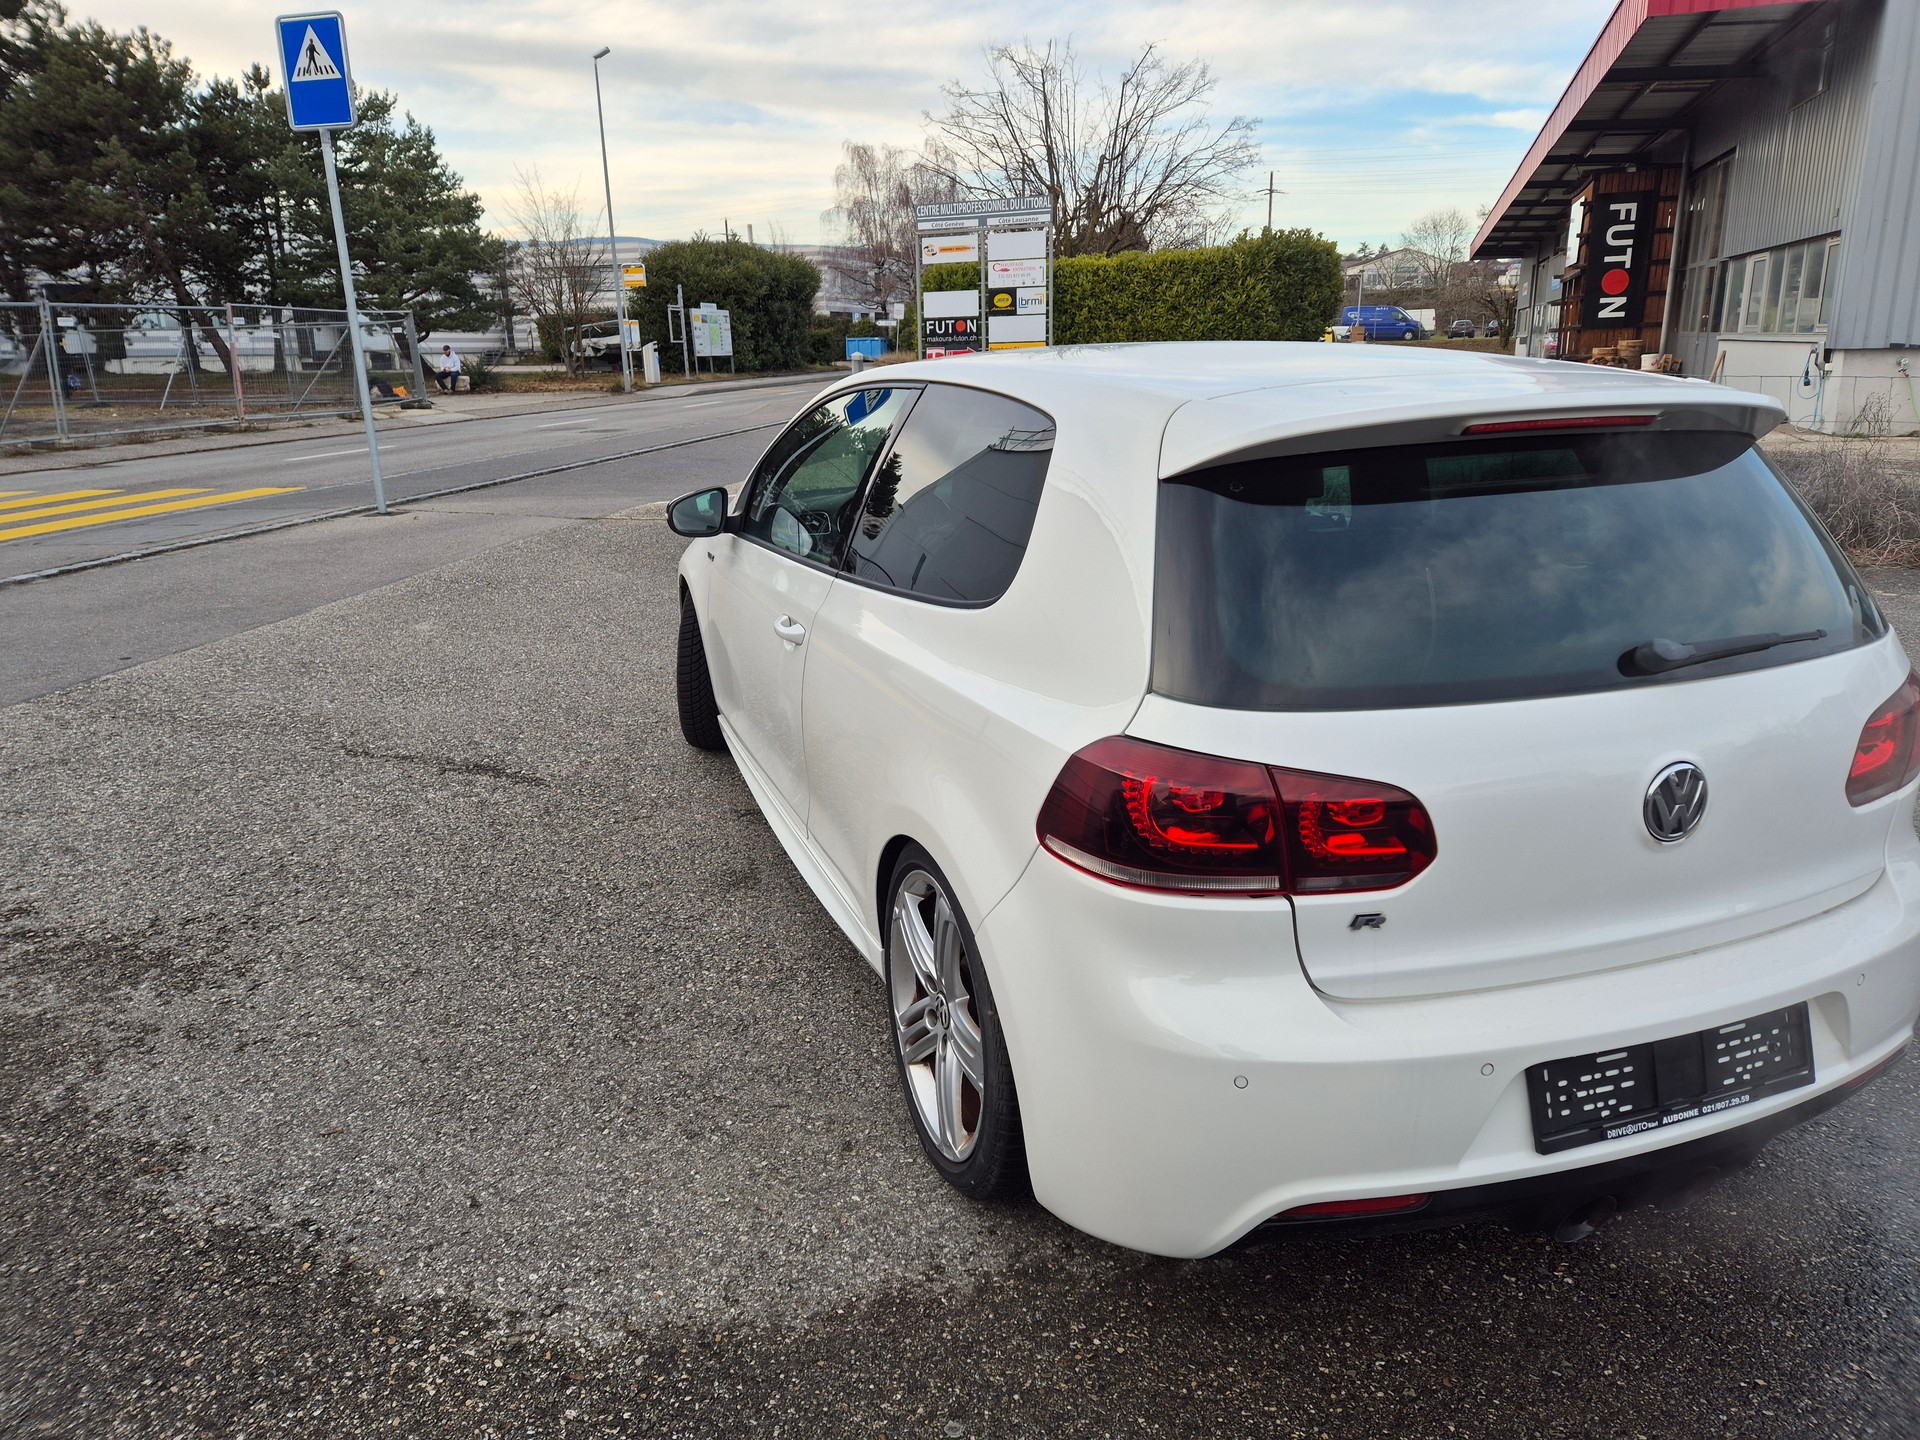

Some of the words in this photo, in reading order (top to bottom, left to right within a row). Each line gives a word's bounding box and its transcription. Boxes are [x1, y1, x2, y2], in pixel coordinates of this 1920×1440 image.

[916, 204, 939, 217] CENTRE
[940, 199, 1009, 215] MULTIPROFESSIONNEL
[1009, 199, 1020, 211] DU
[1020, 196, 1051, 209] LITTORAL
[944, 220, 965, 228] Genève
[926, 334, 978, 343] makoura-futon.ch
[1350, 913, 1386, 930] R
[1662, 1108, 1700, 1124] AUBONNE
[1702, 1095, 1750, 1114] 021/807.29.59
